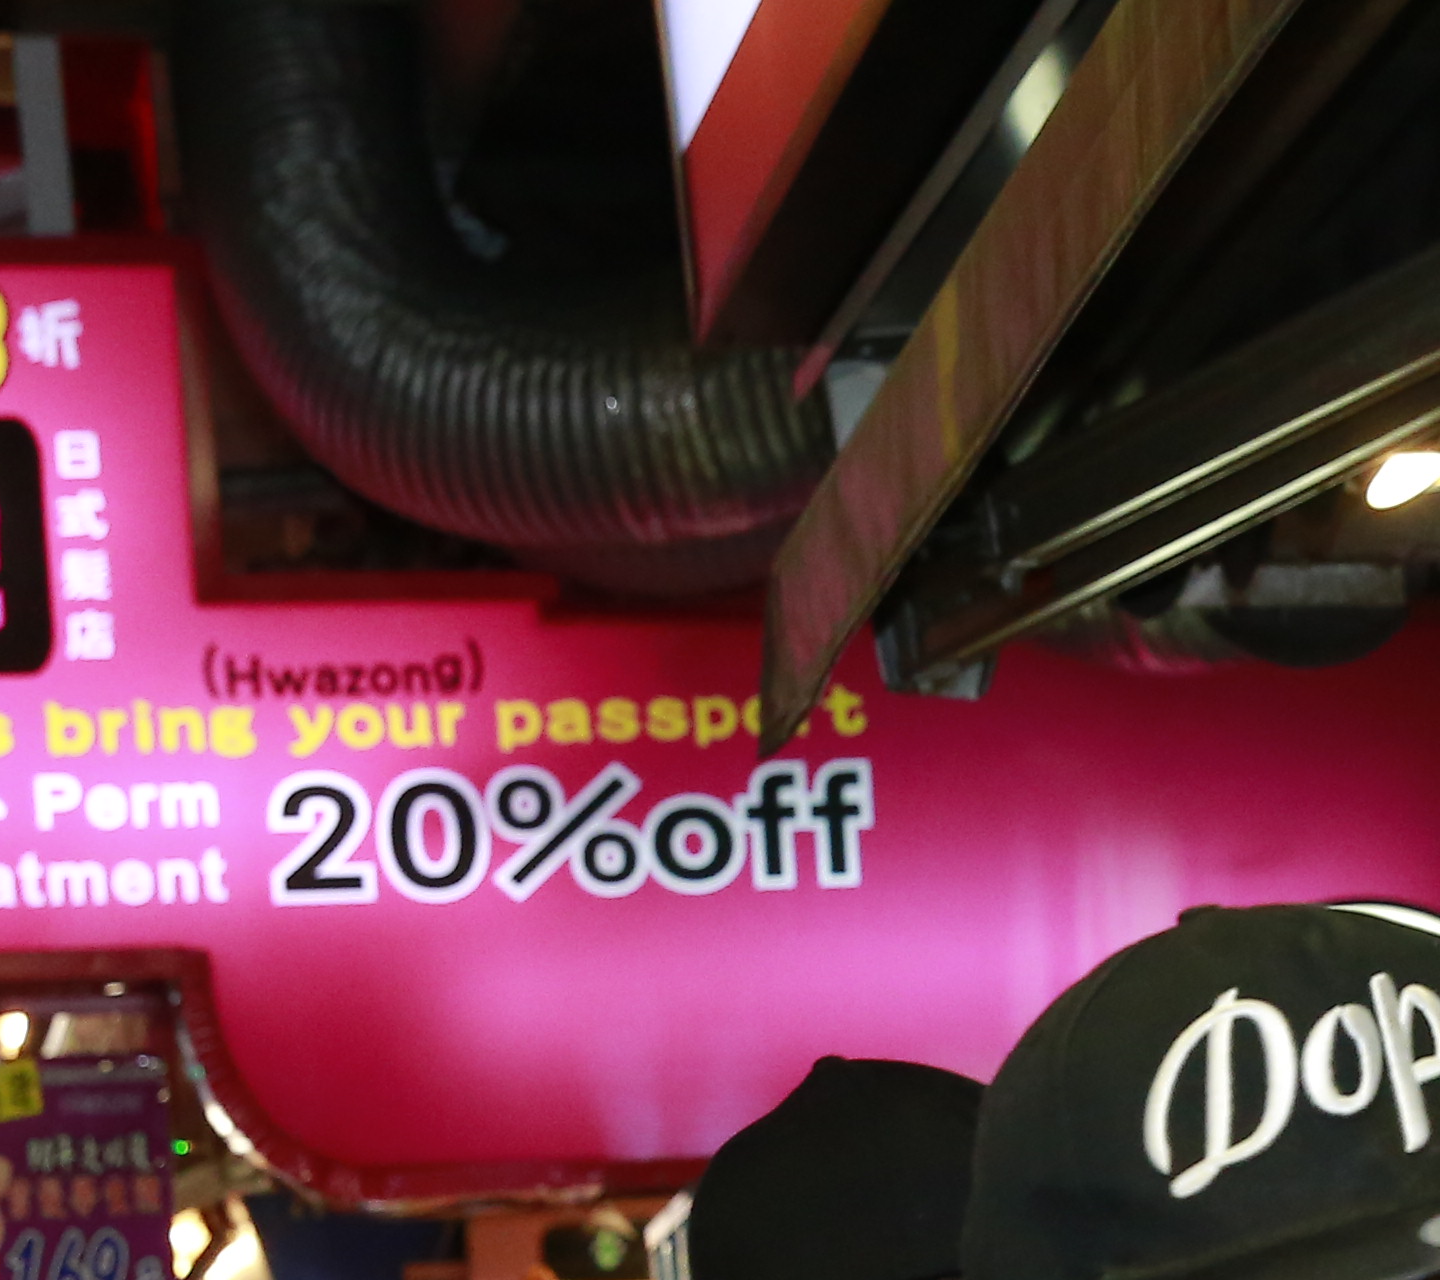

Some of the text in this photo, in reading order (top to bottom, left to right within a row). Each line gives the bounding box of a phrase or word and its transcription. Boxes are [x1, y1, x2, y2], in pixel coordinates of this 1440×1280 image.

[45, 696, 257, 758] bring
[288, 696, 469, 757] your
[33, 772, 220, 832] Perm
[269, 757, 876, 908] 20%off
